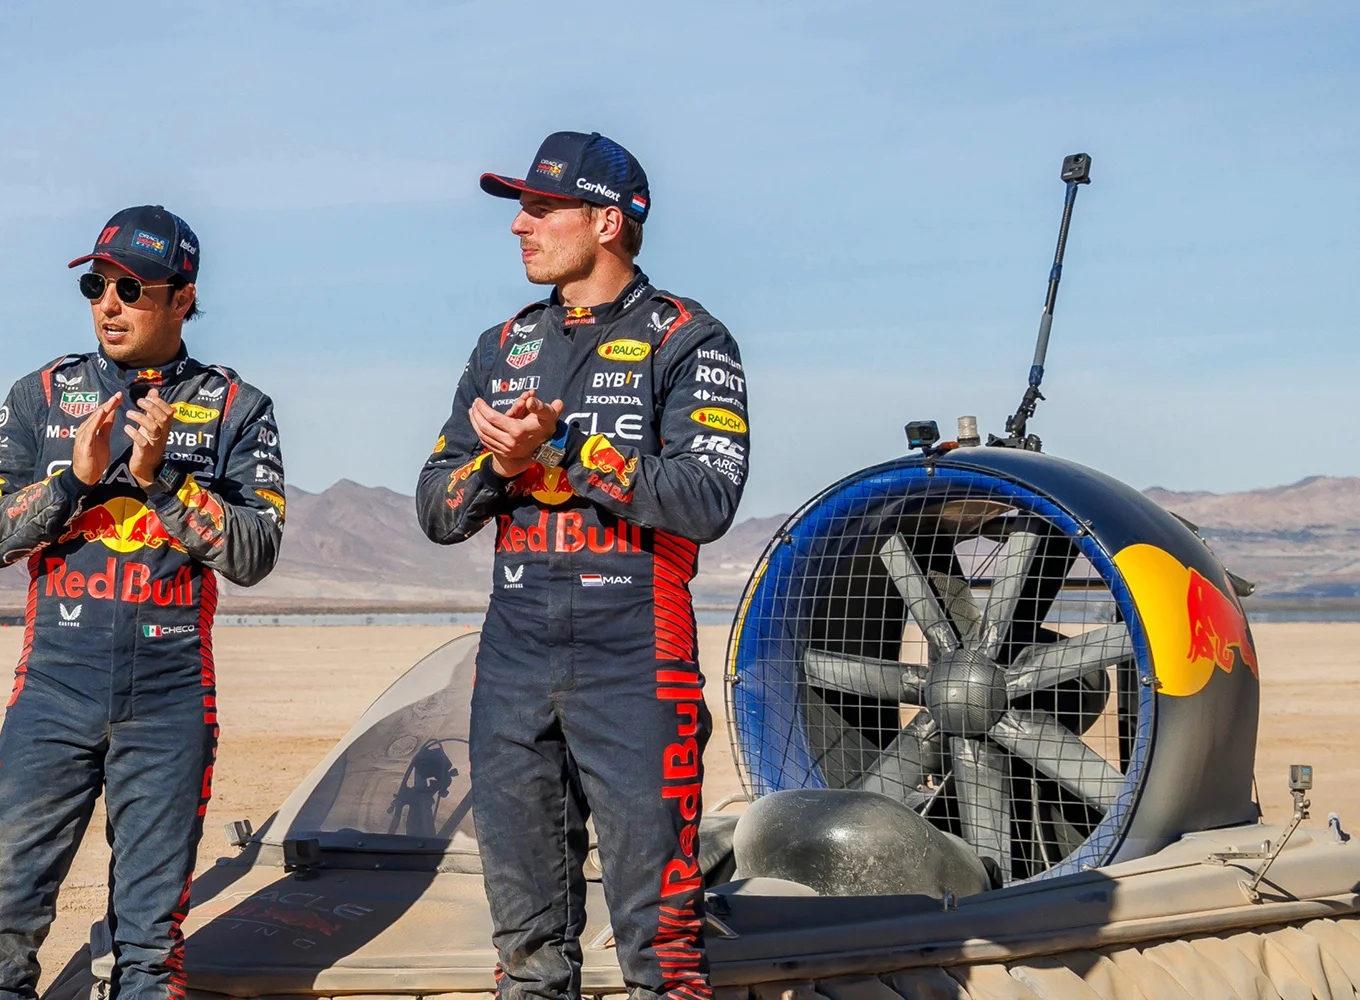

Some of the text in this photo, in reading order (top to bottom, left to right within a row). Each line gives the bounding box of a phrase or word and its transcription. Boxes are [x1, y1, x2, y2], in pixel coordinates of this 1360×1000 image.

[576, 177, 621, 202] CarNext
[98, 226, 120, 245] 11
[516, 342, 540, 355] TAG
[612, 344, 647, 357] RAUCH
[592, 370, 643, 389] BYBIT
[695, 364, 745, 393] ROKT
[64, 393, 97, 402] TAG
[585, 395, 643, 406] HONDA
[178, 407, 212, 420] RAUCH
[707, 413, 741, 430] RAUCH
[46, 425, 77, 438] Mob
[564, 412, 644, 440] CLE
[609, 484, 635, 504] Bull
[496, 509, 642, 554] Red Bull
[44, 556, 193, 606] Red Bull
[602, 575, 633, 585] MAX
[161, 624, 195, 634] CHECO
[656, 670, 703, 898] Red Bull
